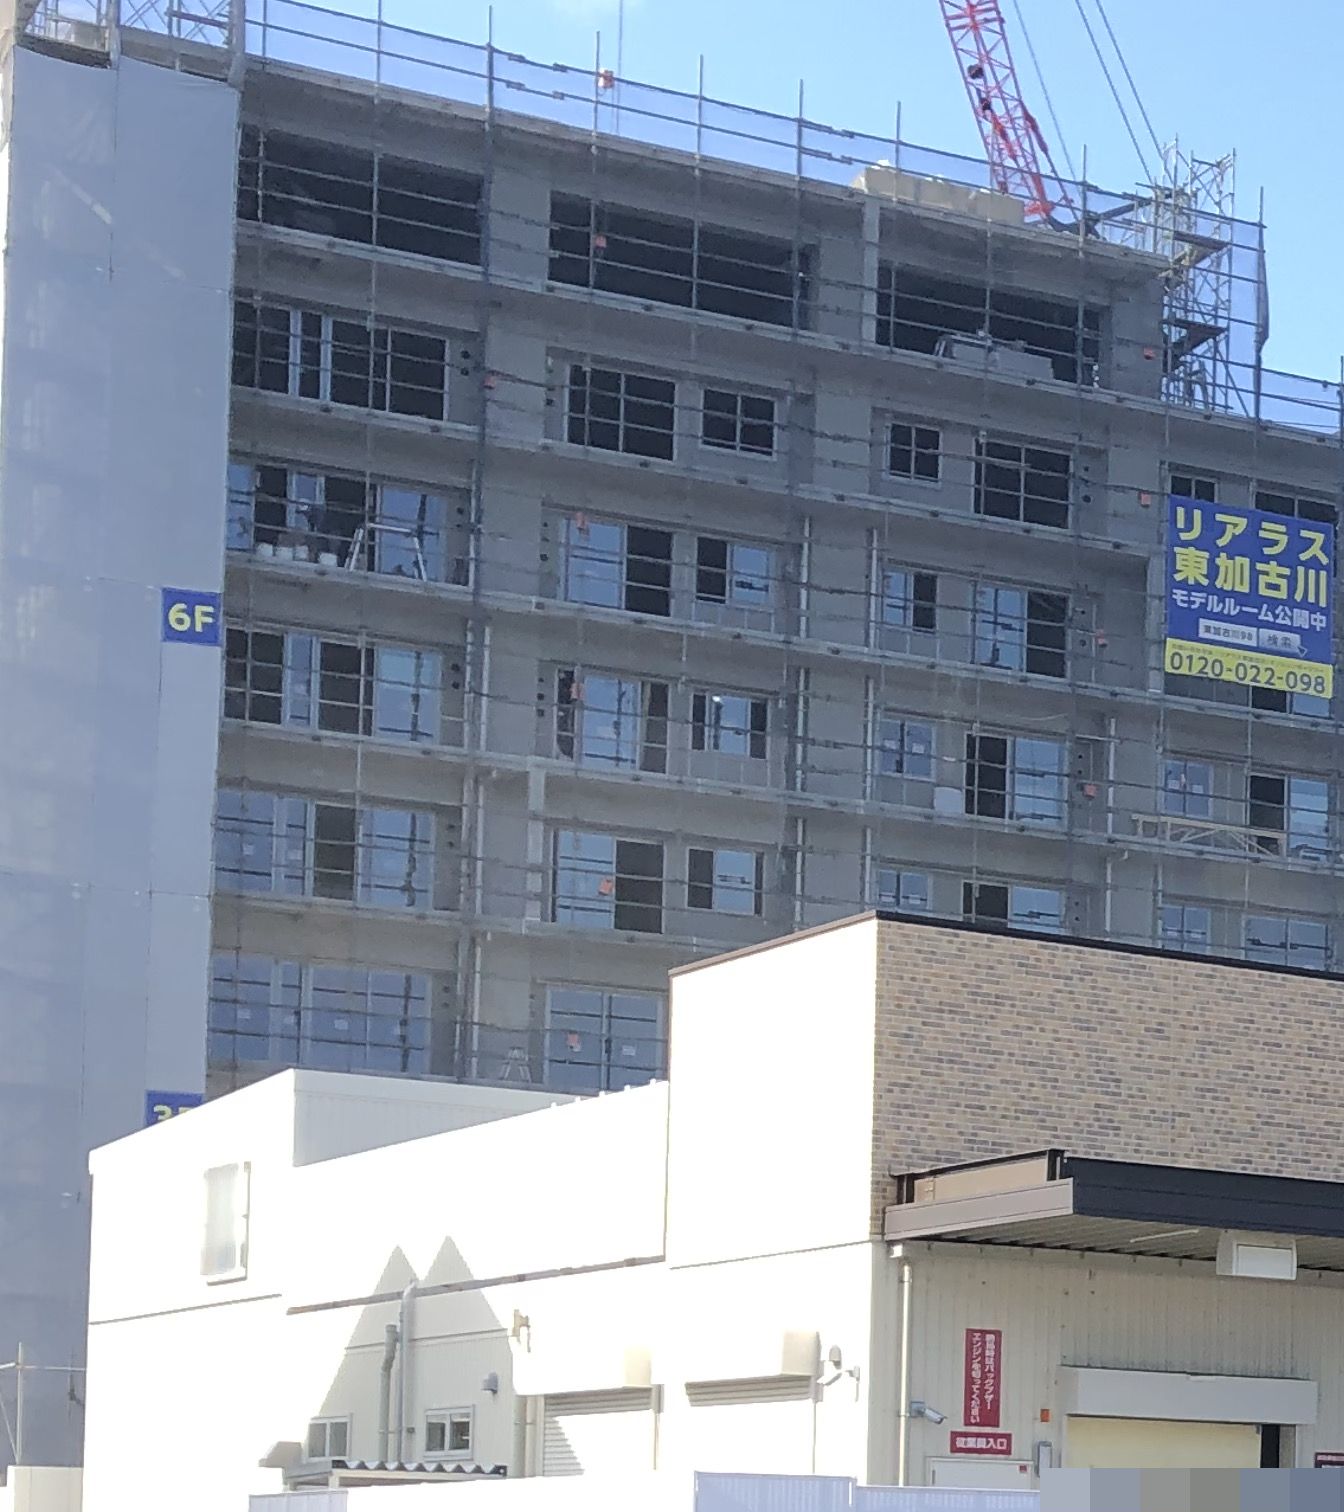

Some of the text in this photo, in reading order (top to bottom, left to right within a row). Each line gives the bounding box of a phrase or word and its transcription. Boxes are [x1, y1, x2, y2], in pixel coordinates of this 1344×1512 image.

[1175, 506, 1329, 566] リアラス
[1173, 546, 1328, 608] 東加古川
[168, 603, 215, 633] 6F
[1171, 588, 1327, 632] モデルルーム公開中
[1170, 651, 1326, 694] 0120-022-098
